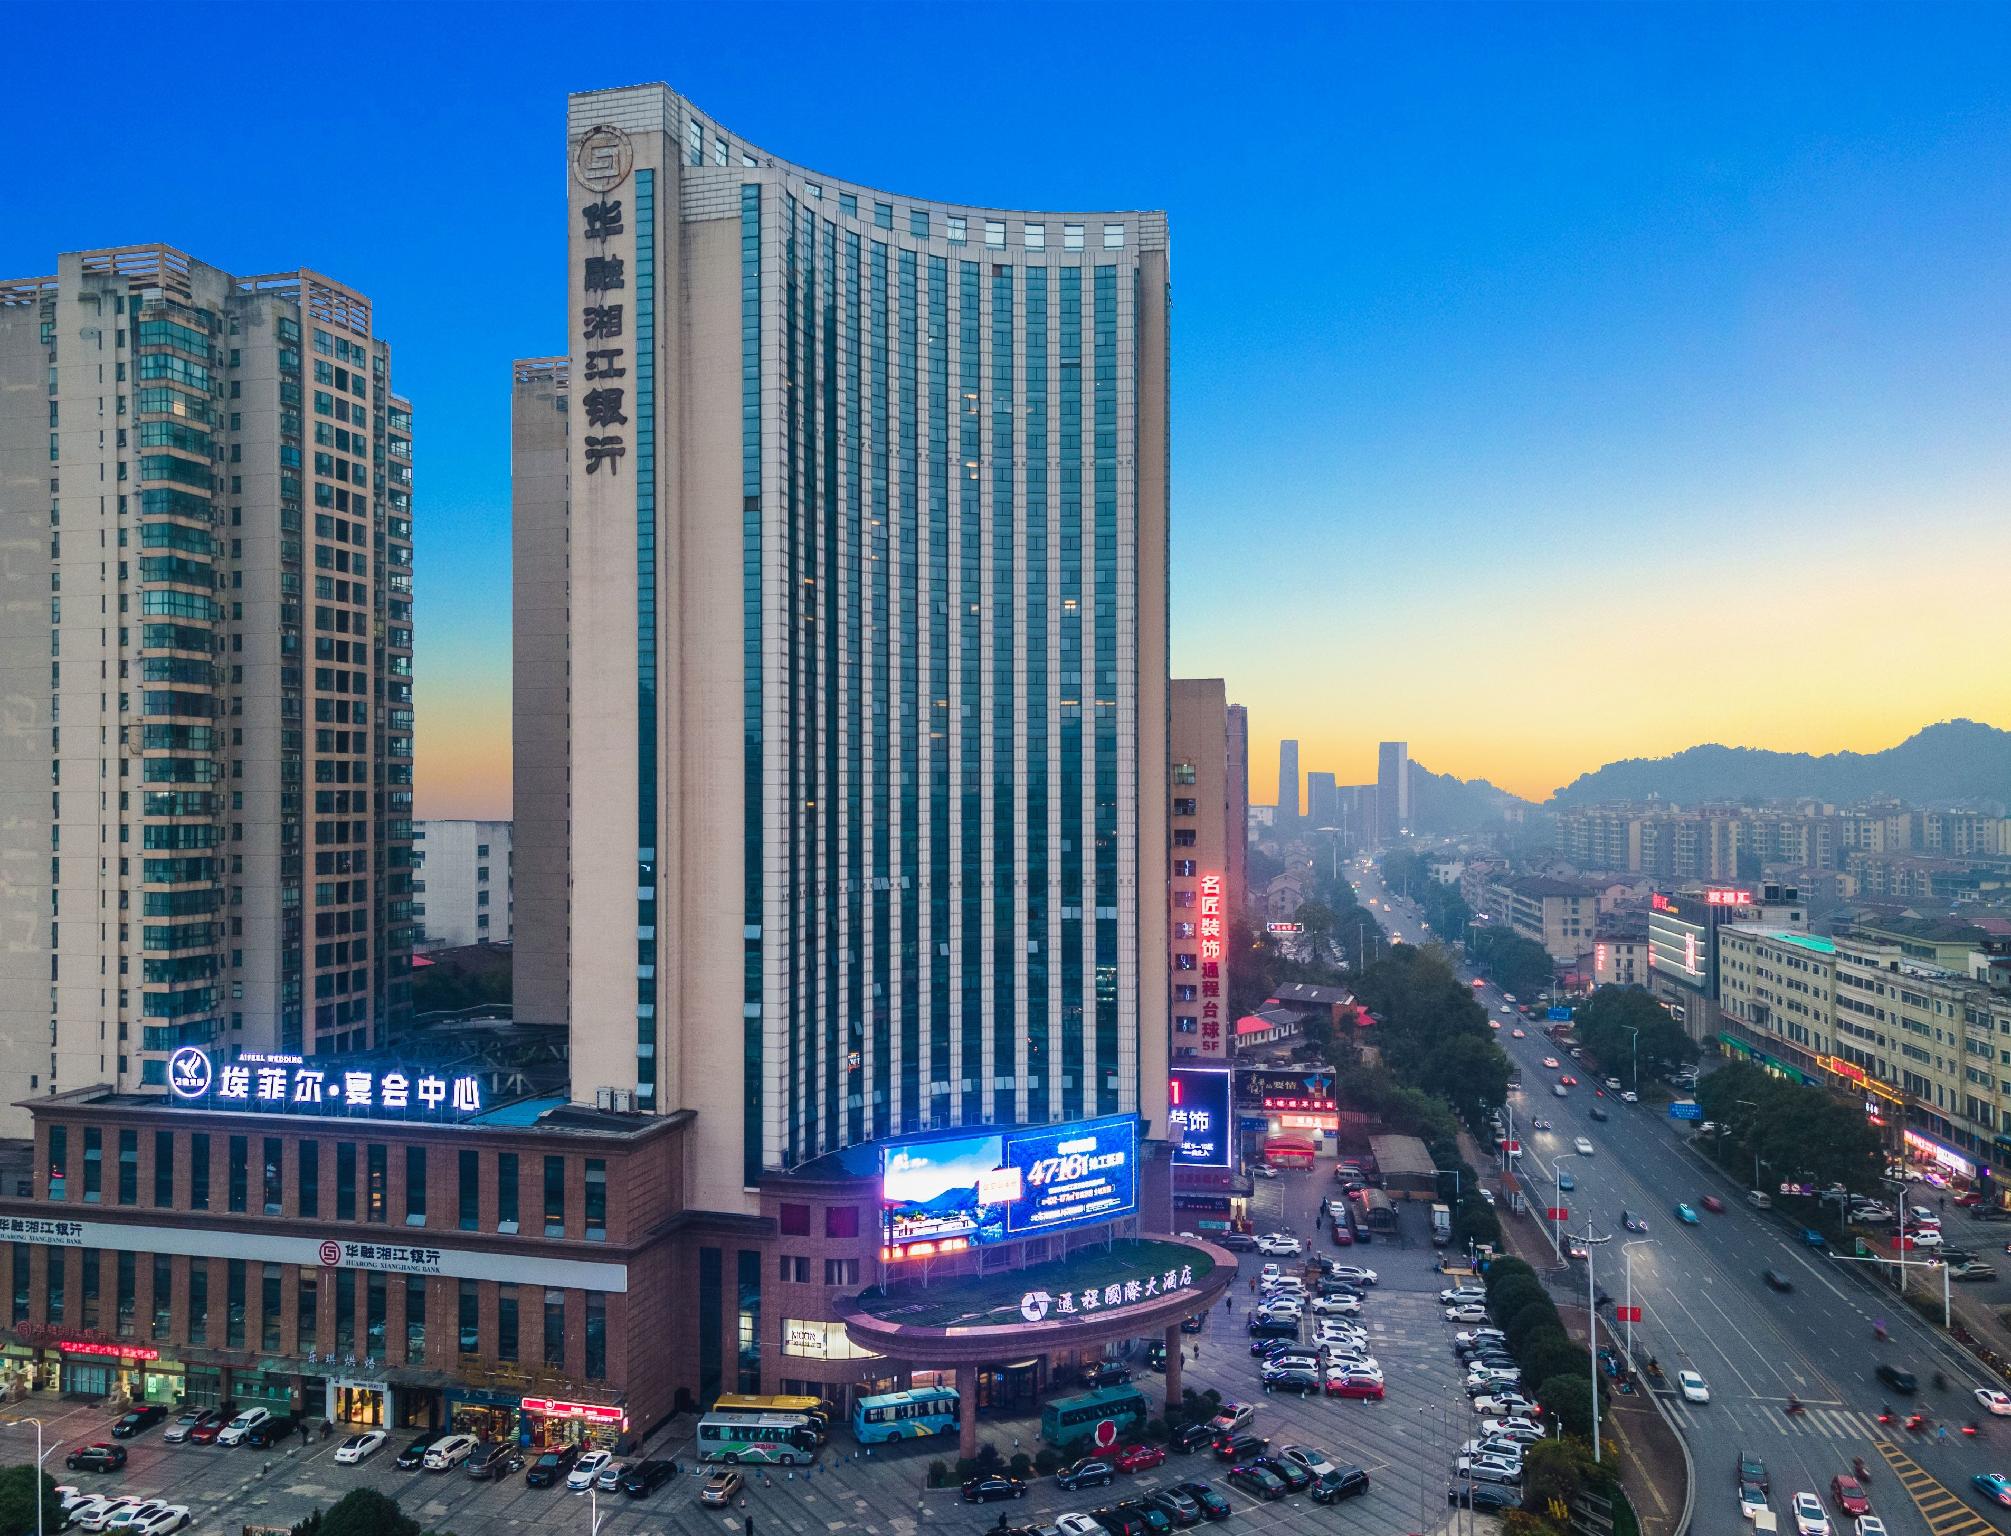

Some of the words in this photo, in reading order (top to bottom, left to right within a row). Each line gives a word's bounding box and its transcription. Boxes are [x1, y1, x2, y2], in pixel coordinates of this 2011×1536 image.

[582, 200, 628, 476] 华融湘江银行
[1201, 876, 1221, 958] 名匠装饰
[1201, 961, 1221, 1038] 通程台球
[0, 1218, 83, 1237] 华融湘江银行
[345, 1244, 440, 1265] 华融湘江银行
[345, 1259, 378, 1268] HUARONG
[380, 1263, 421, 1272] XIANGJIANG
[1056, 1264, 1193, 1314] 通程國際大酒店
